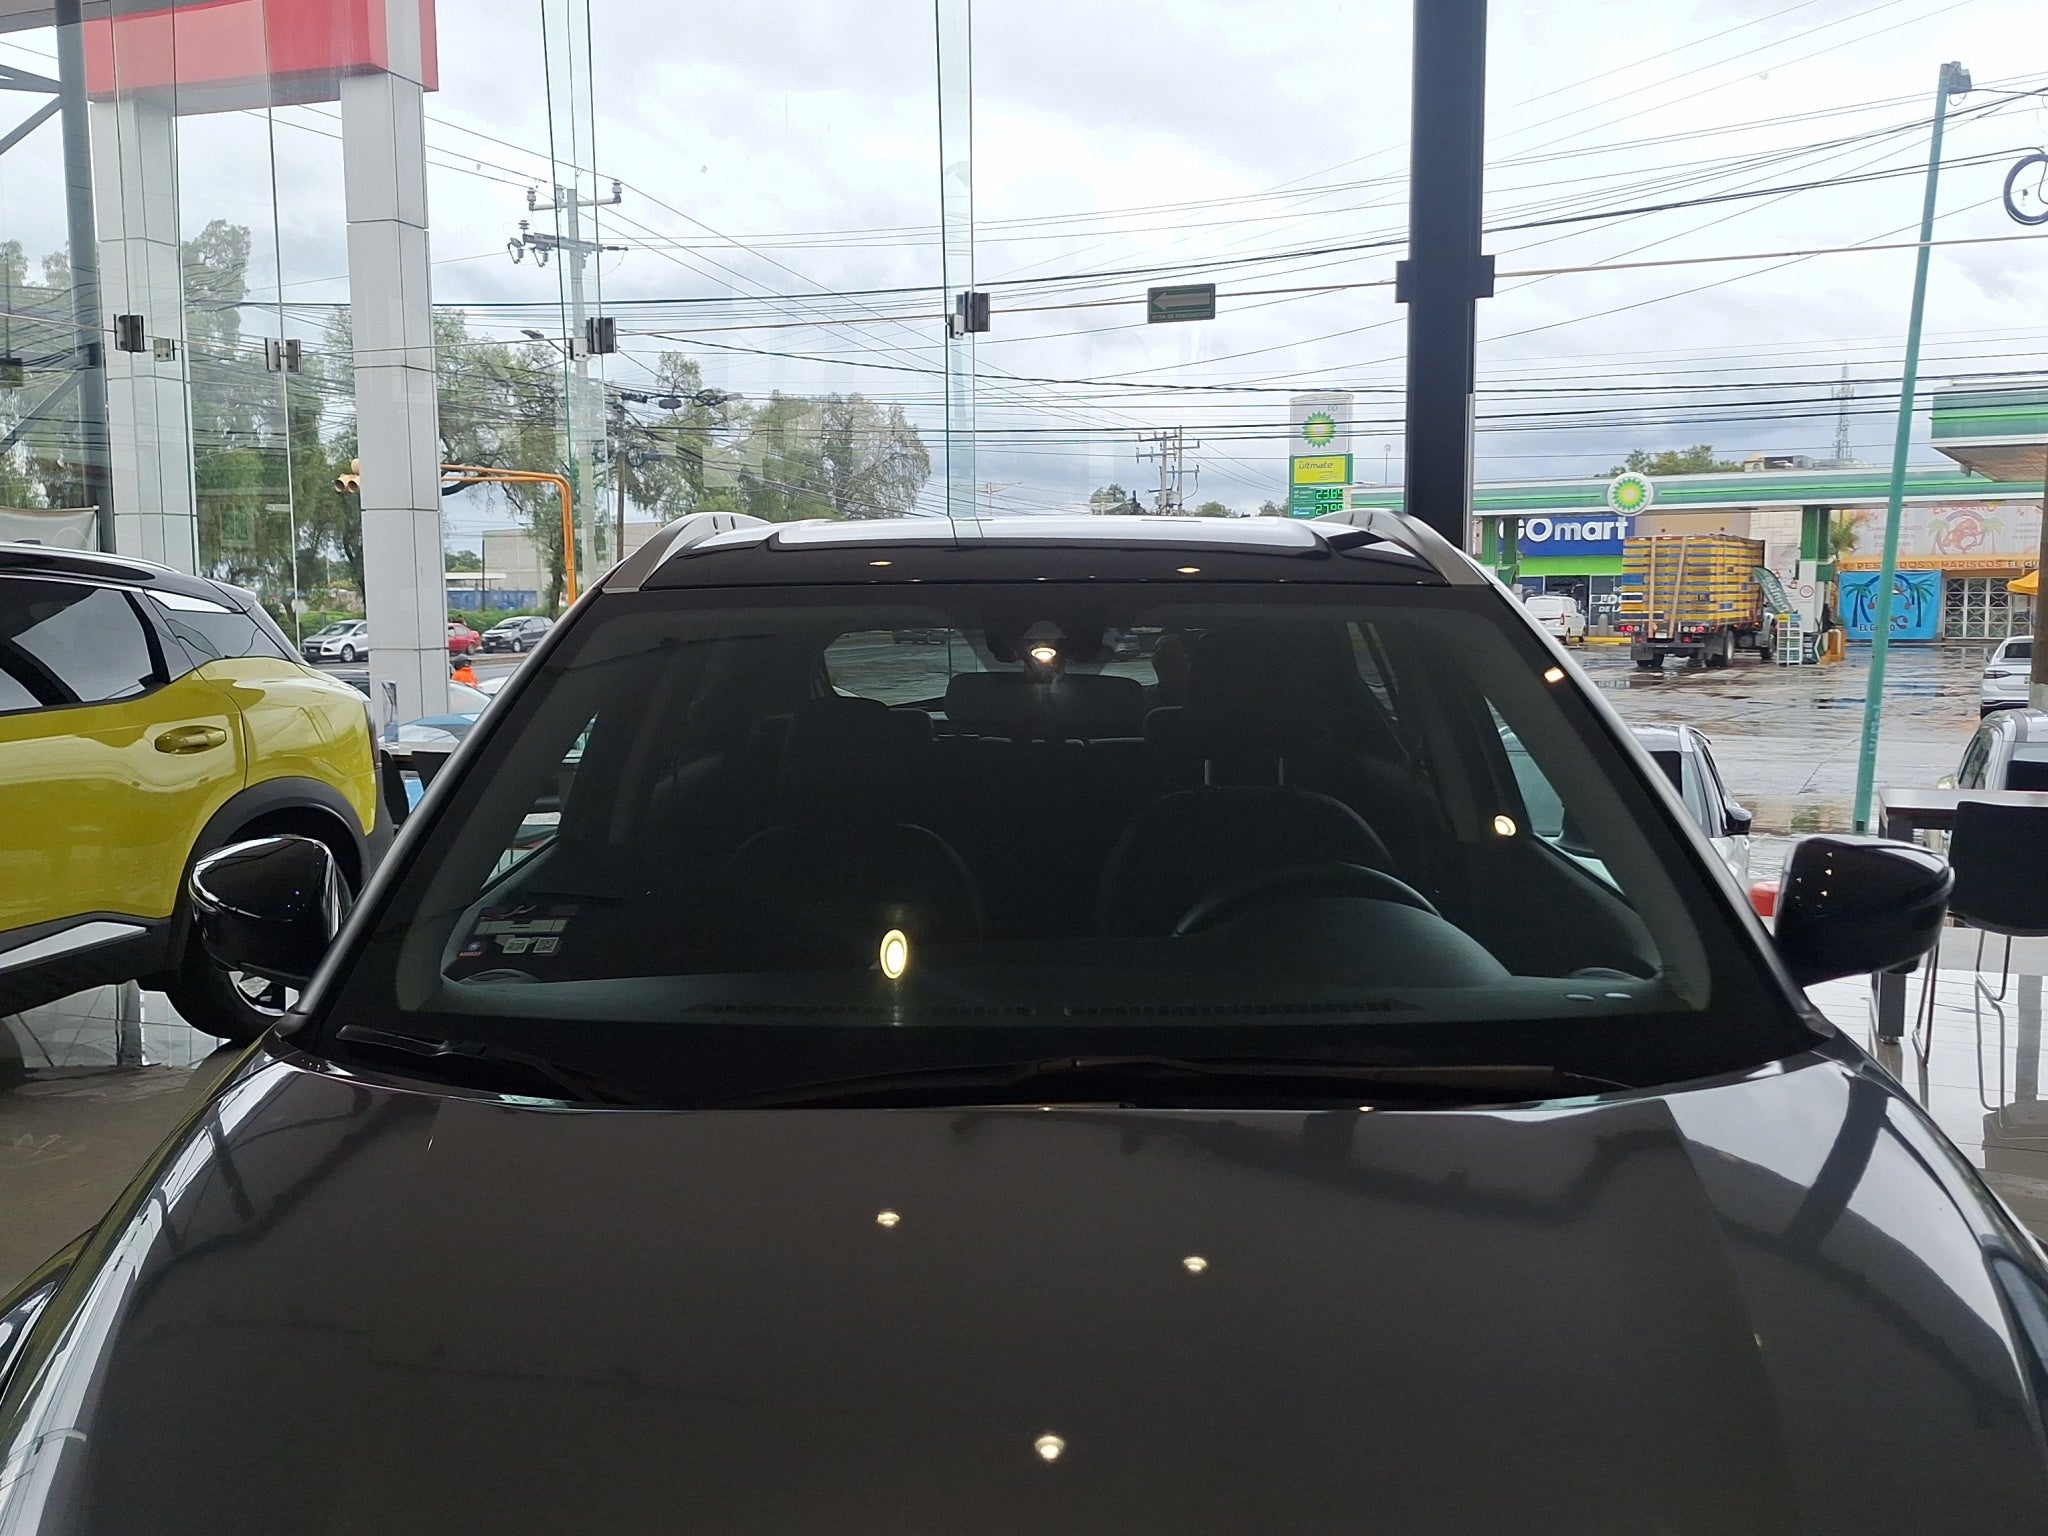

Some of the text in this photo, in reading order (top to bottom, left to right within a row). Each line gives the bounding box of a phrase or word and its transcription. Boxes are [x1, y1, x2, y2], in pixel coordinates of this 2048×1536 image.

[1857, 561, 1925, 570] PESDOS
[1929, 561, 1937, 569] Y
[1941, 560, 2001, 569] MARISCOS
